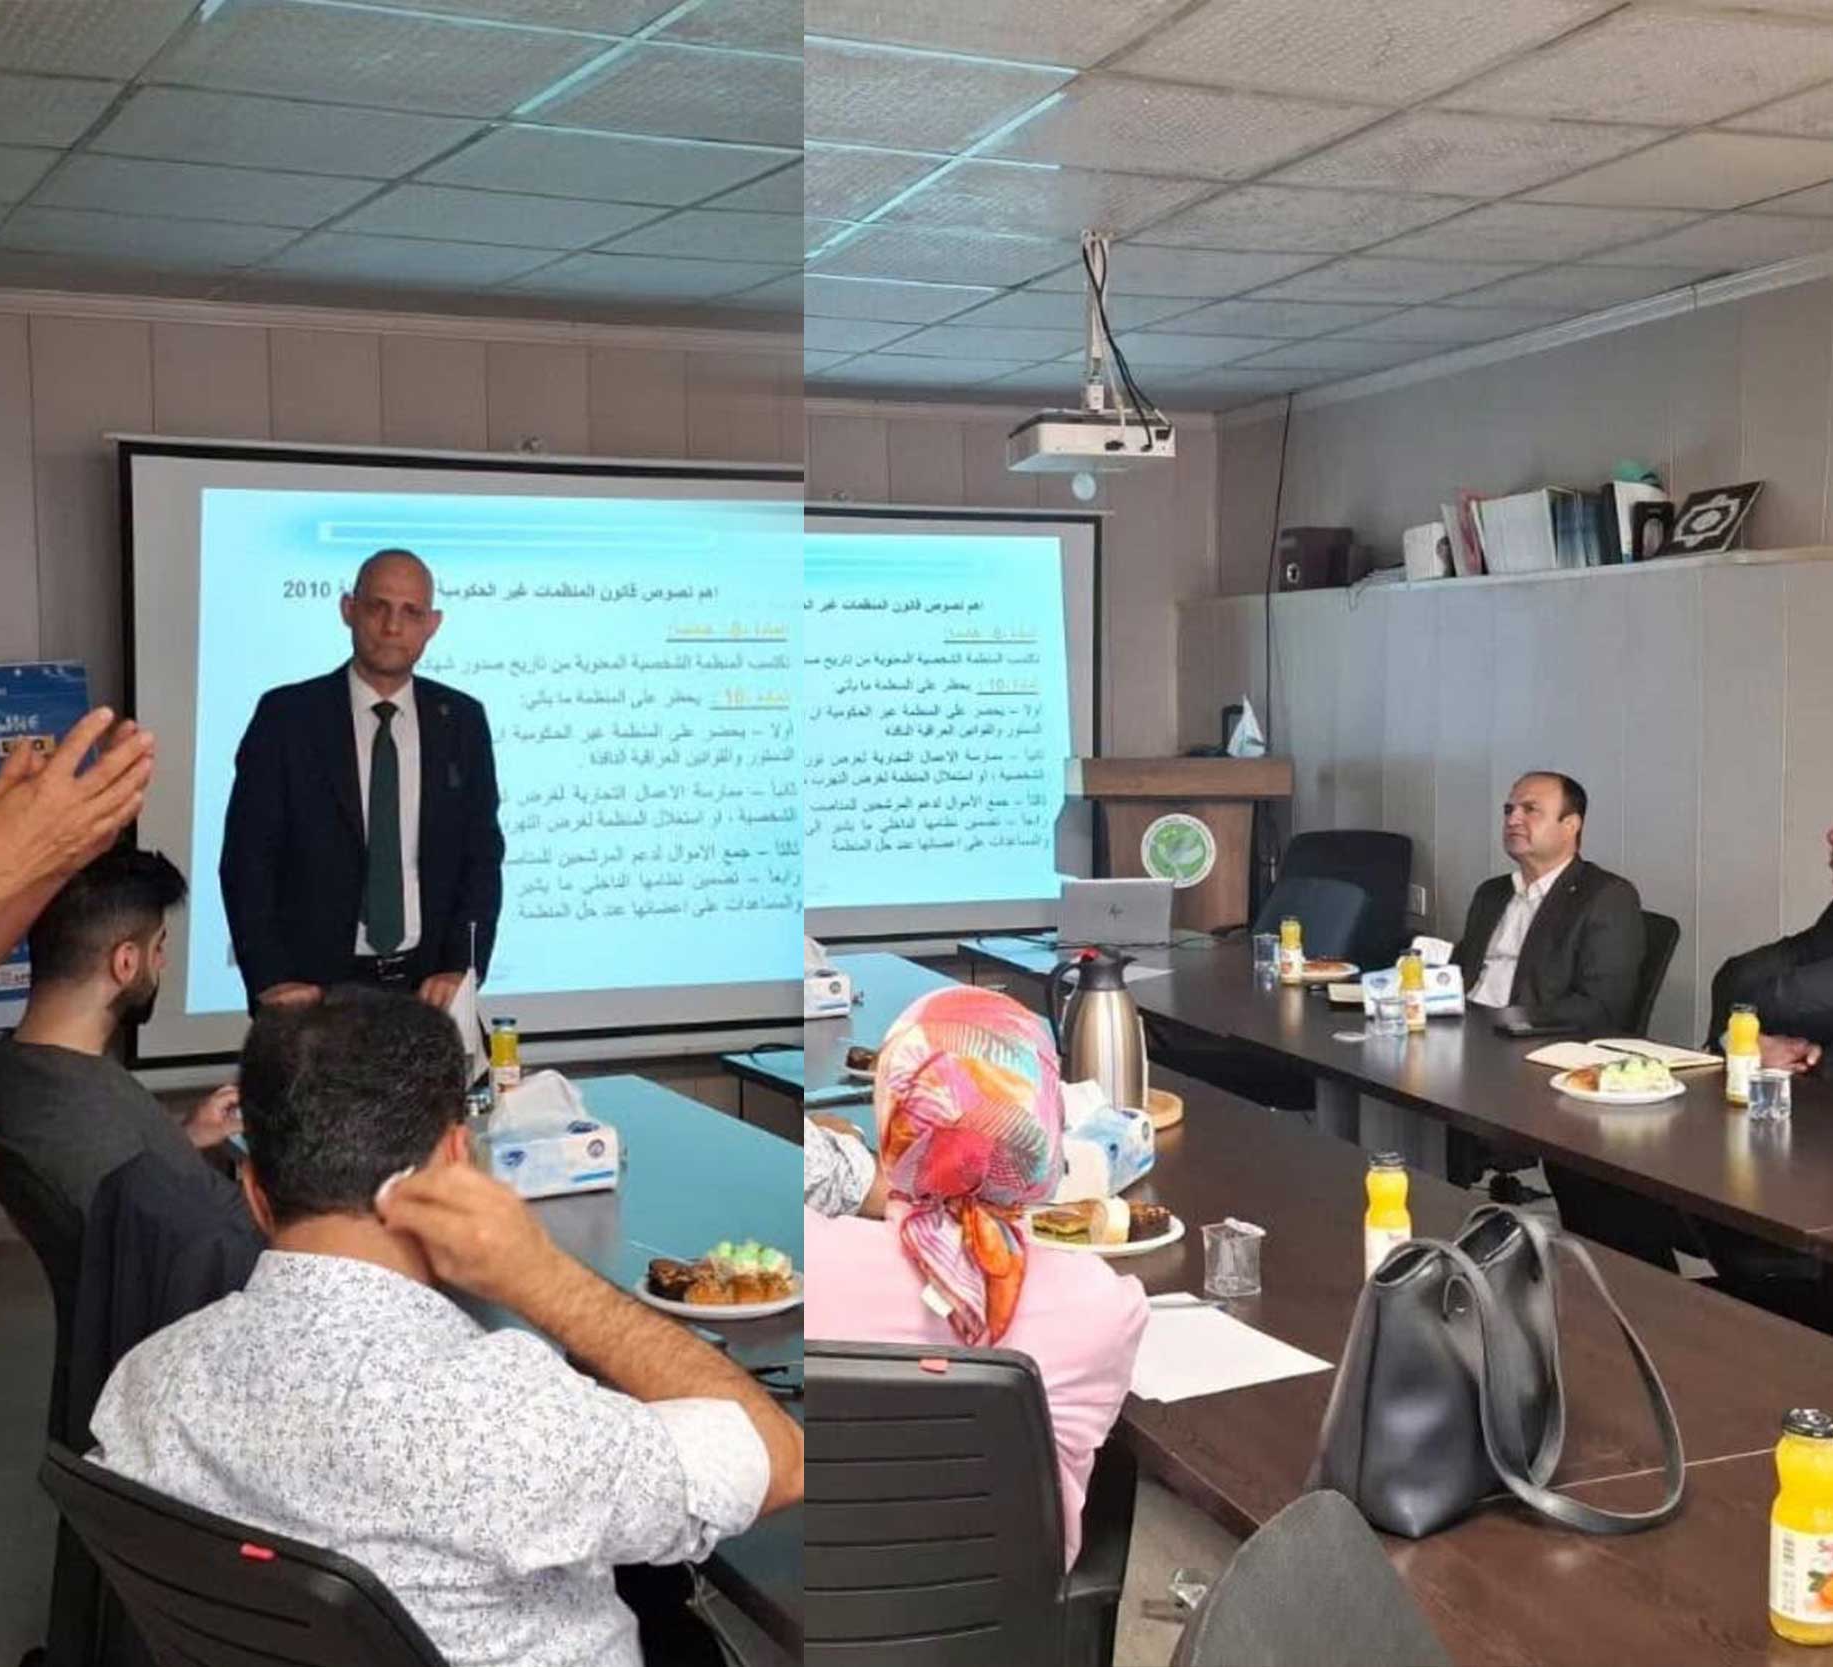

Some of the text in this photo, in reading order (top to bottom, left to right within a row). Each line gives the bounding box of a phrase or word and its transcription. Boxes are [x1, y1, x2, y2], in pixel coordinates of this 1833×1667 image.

[283, 581, 332, 599] 2010
[503, 583, 527, 602] غير
[534, 582, 594, 600] المنظمات
[601, 582, 637, 602] قانون
